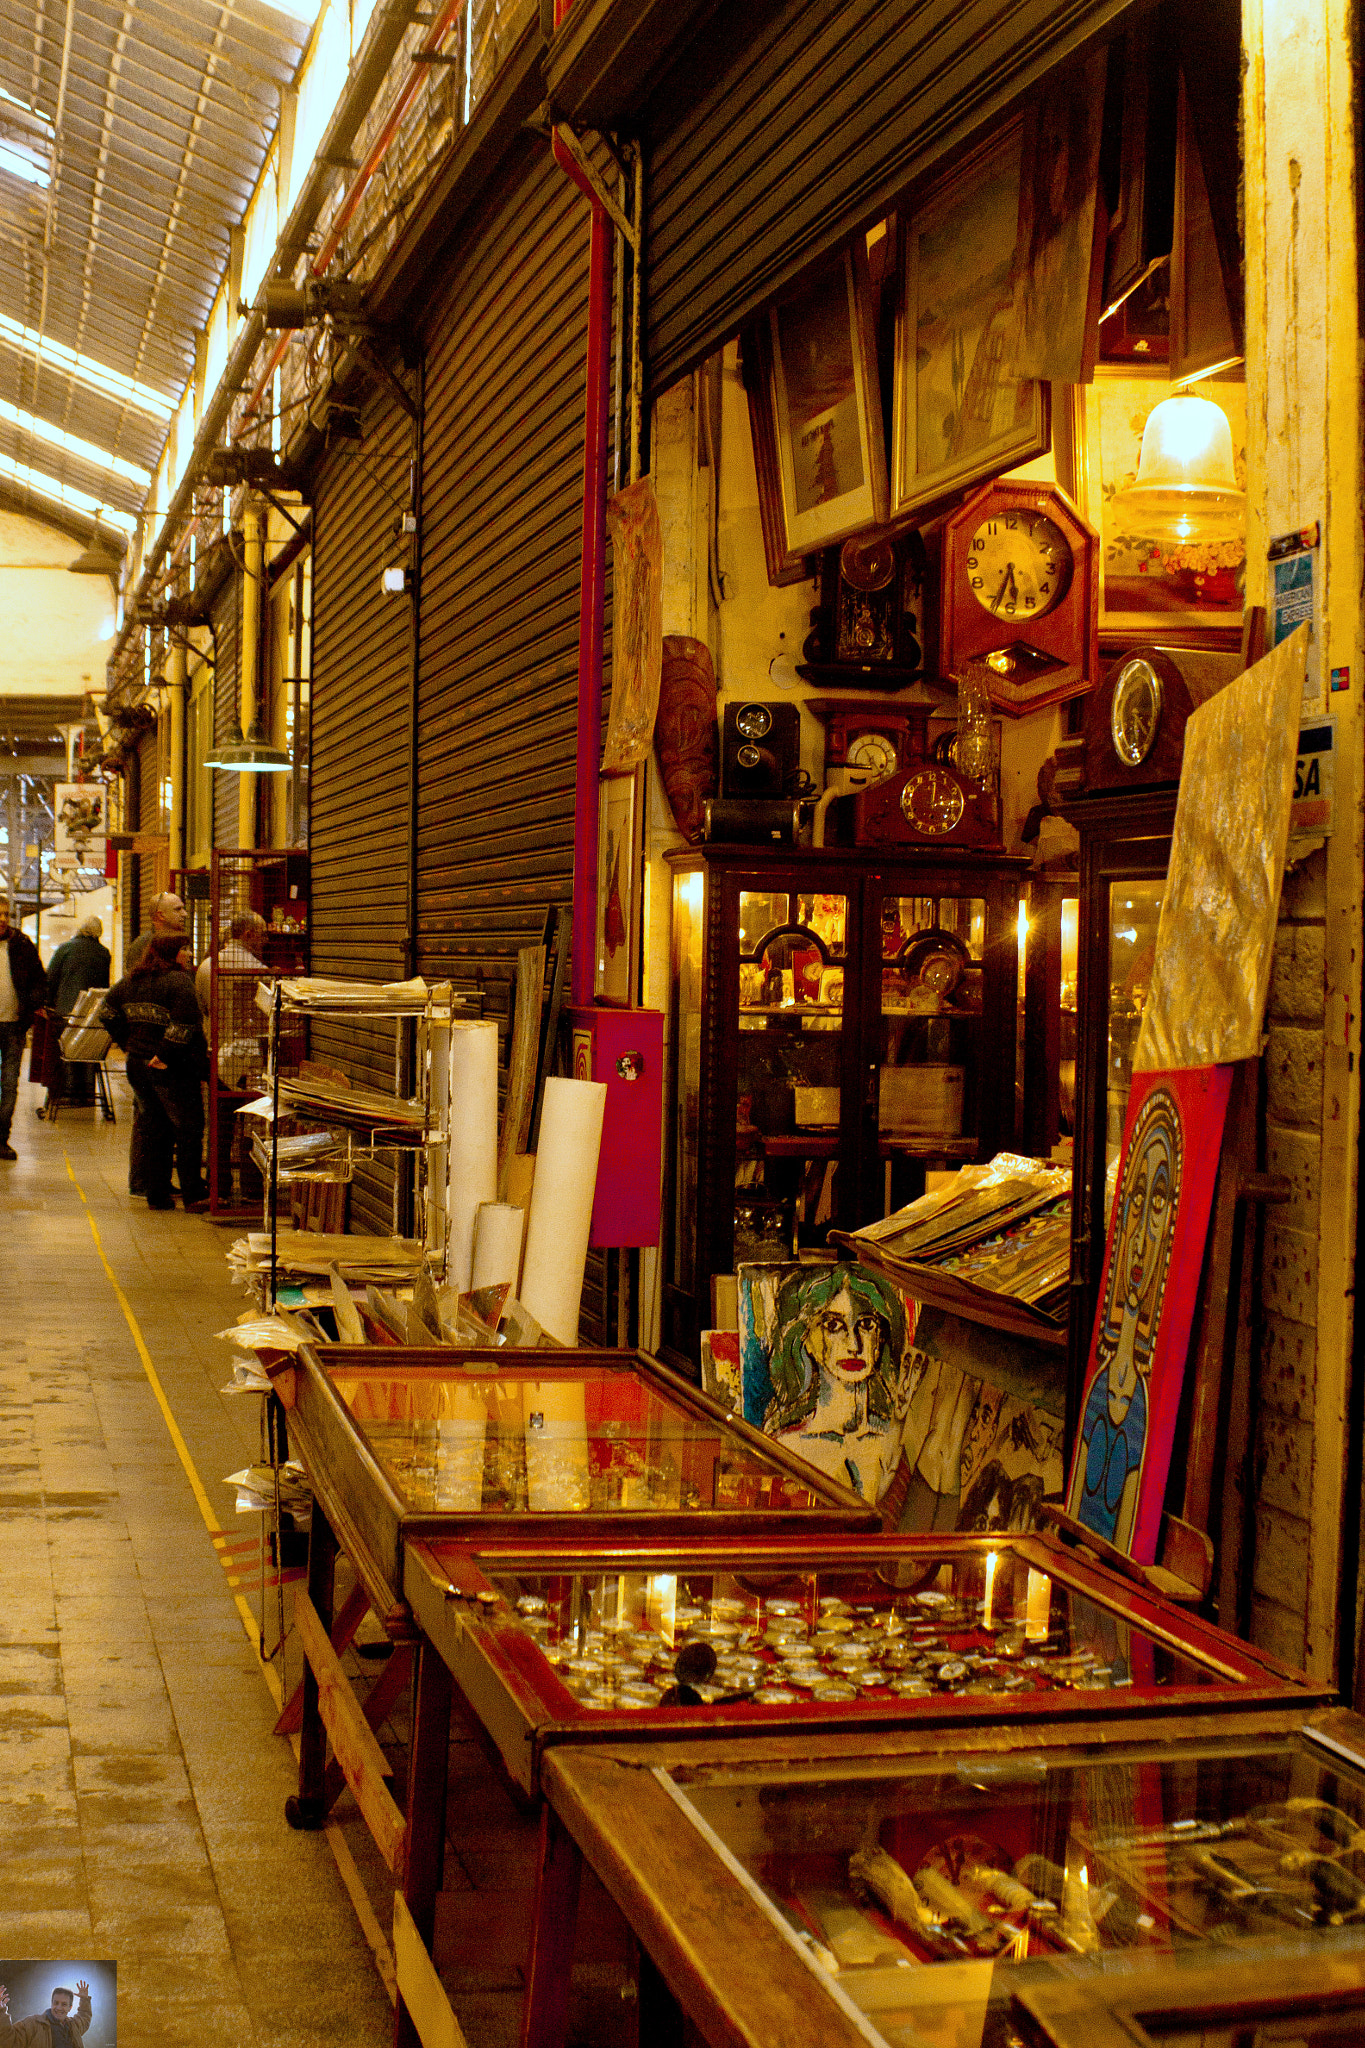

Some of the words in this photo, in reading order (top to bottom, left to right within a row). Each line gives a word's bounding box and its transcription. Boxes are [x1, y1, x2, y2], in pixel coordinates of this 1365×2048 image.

[987, 523, 997, 535] 11
[1004, 517, 1018, 530] 12
[972, 538, 985, 551] 10
[1039, 541, 1051, 554] 2
[967, 557, 978, 569] 9
[1046, 562, 1056, 575] 3
[971, 576, 984, 589] 8
[1039, 581, 1050, 594] 4
[1025, 596, 1036, 609] 5
[1275, 587, 1312, 605] AMERICAN
[1004, 602, 1015, 614] 6
[1282, 604, 1313, 622] EXPRESS
[929, 773, 936, 781] 12
